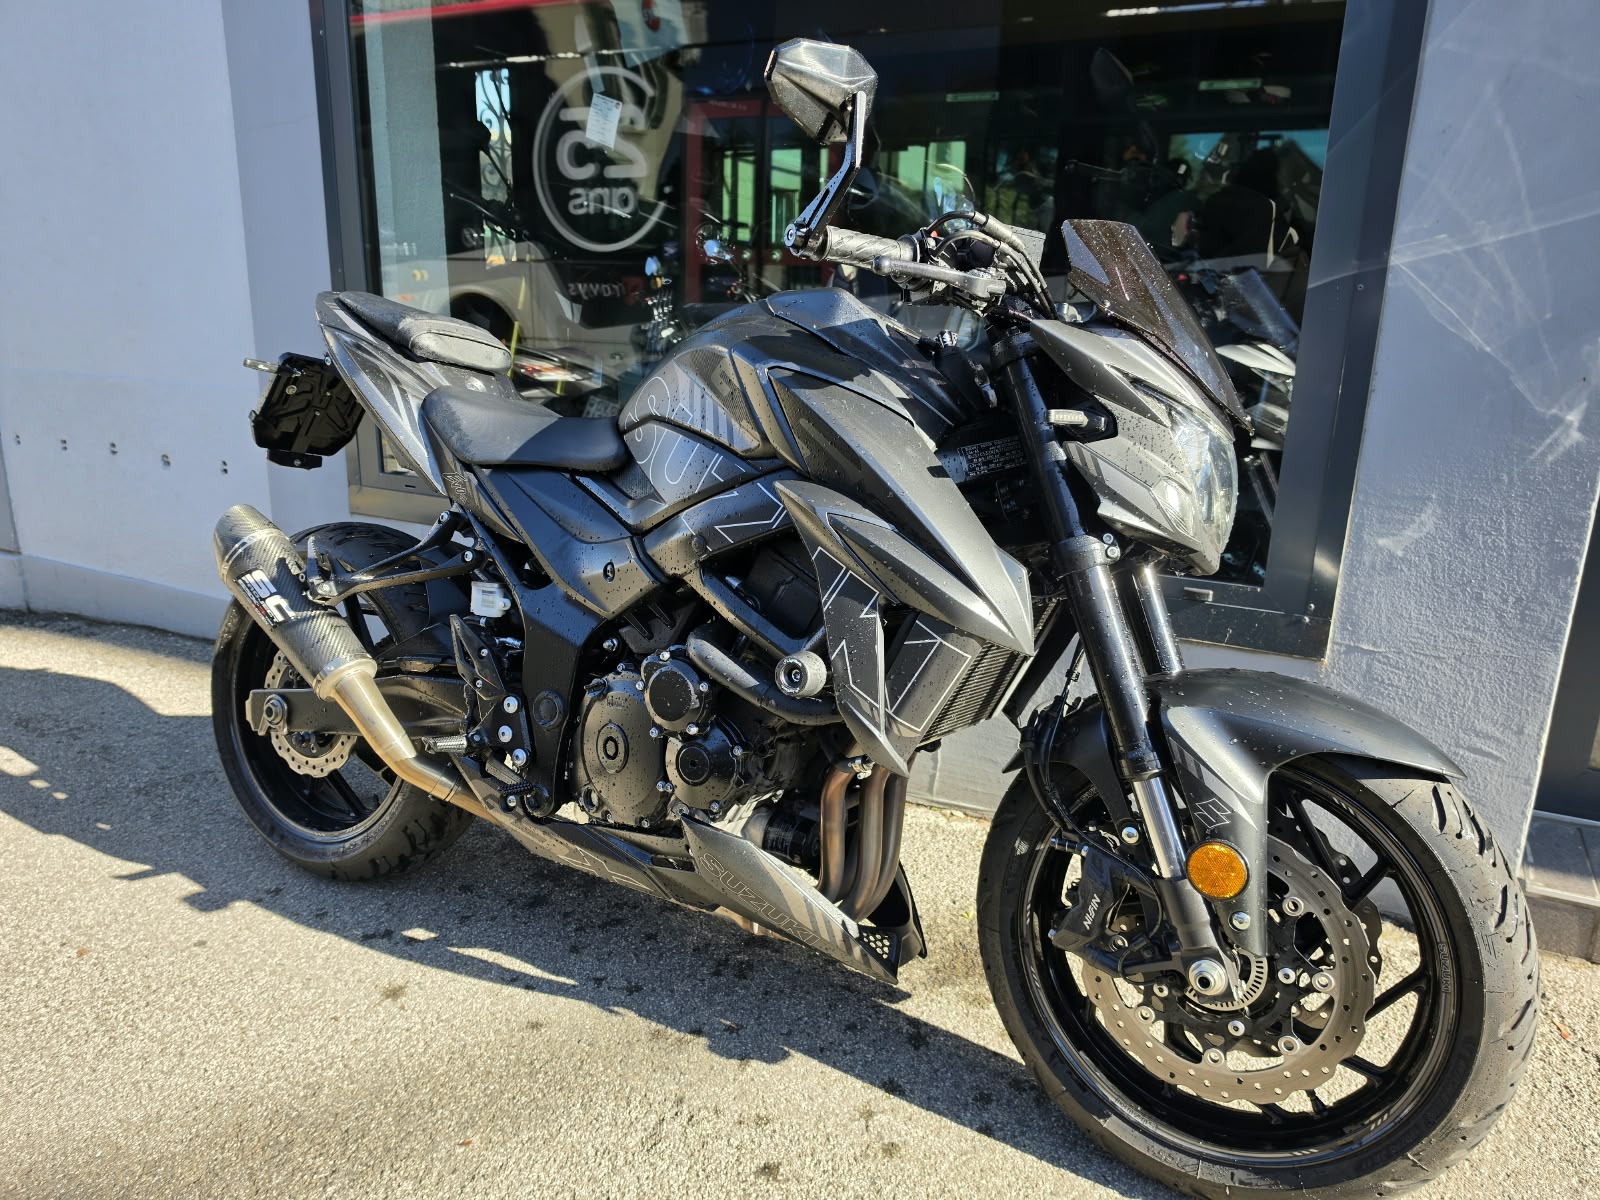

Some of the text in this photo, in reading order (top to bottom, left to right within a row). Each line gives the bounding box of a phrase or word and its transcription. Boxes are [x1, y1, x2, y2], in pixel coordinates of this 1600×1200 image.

[700, 852, 820, 946] SUZUKI
[1083, 893, 1101, 931] NISSIN
[1439, 942, 1451, 993] SUZUKI
